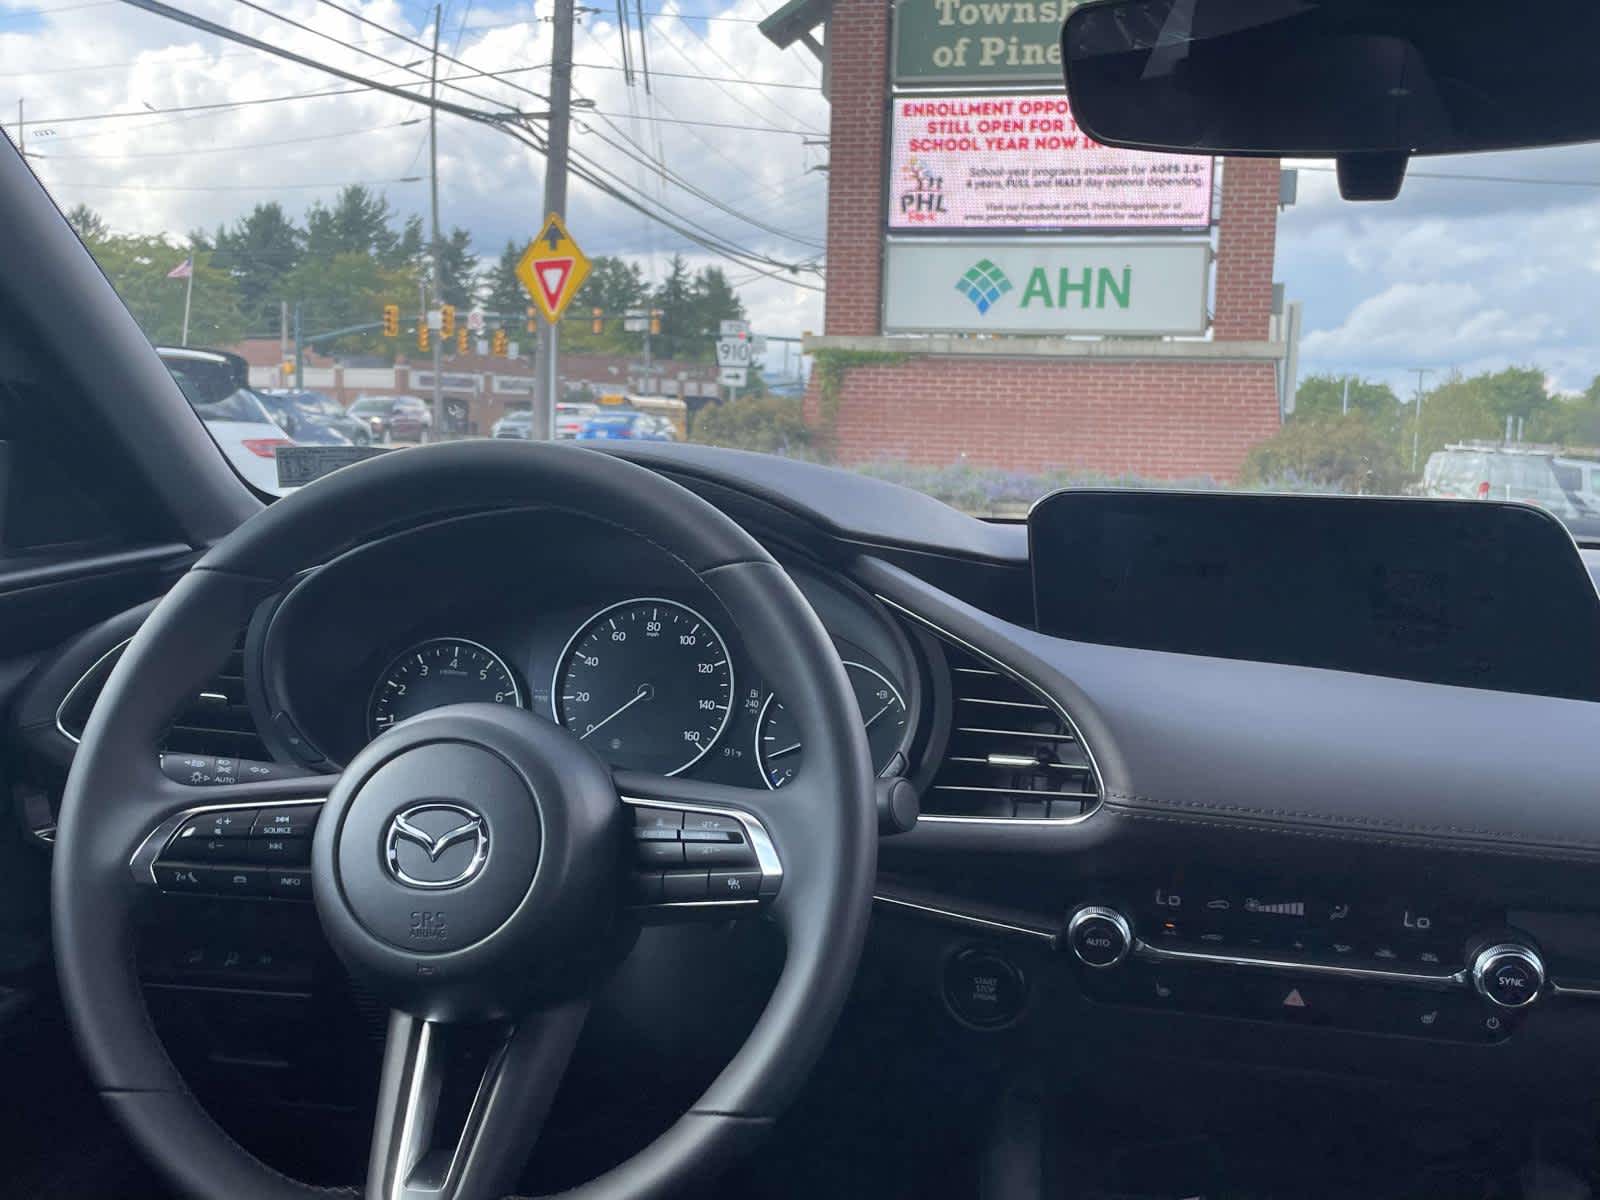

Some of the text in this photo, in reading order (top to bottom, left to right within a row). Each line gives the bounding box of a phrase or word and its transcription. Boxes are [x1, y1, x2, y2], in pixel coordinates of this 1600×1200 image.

[933, 36, 1062, 67] of Pine
[903, 102, 1014, 117] ENROLLMENT
[927, 120, 972, 133] STILL
[977, 119, 1024, 133] OPEN
[1030, 119, 1064, 132] FOR
[909, 137, 980, 152] SCHOOL
[984, 137, 1029, 151] YEAR
[1034, 136, 1078, 150] NOW
[901, 193, 948, 213] PHL
[1020, 266, 1132, 309] AHN
[720, 343, 750, 361] 910
[646, 621, 662, 632] 80
[611, 631, 627, 642] 60
[679, 636, 696, 646] 100
[449, 658, 459, 669] 4
[584, 656, 599, 667] 40
[419, 665, 429, 676] 3
[698, 663, 714, 674] 120
[479, 670, 488, 680] 5
[397, 684, 407, 695] 2
[495, 692, 504, 703] 6
[575, 691, 590, 702] 20
[698, 699, 716, 711] 140
[744, 700, 760, 709] 240
[389, 713, 395, 723] 1
[683, 730, 700, 742] 160
[785, 768, 793, 777] C
[214, 776, 236, 785] AUTO
[263, 826, 293, 835] SOURCE
[281, 877, 301, 886] INFO
[1403, 911, 1431, 929] Lo
[1086, 937, 1111, 949] AUTO
[1498, 975, 1526, 988] SYNC
